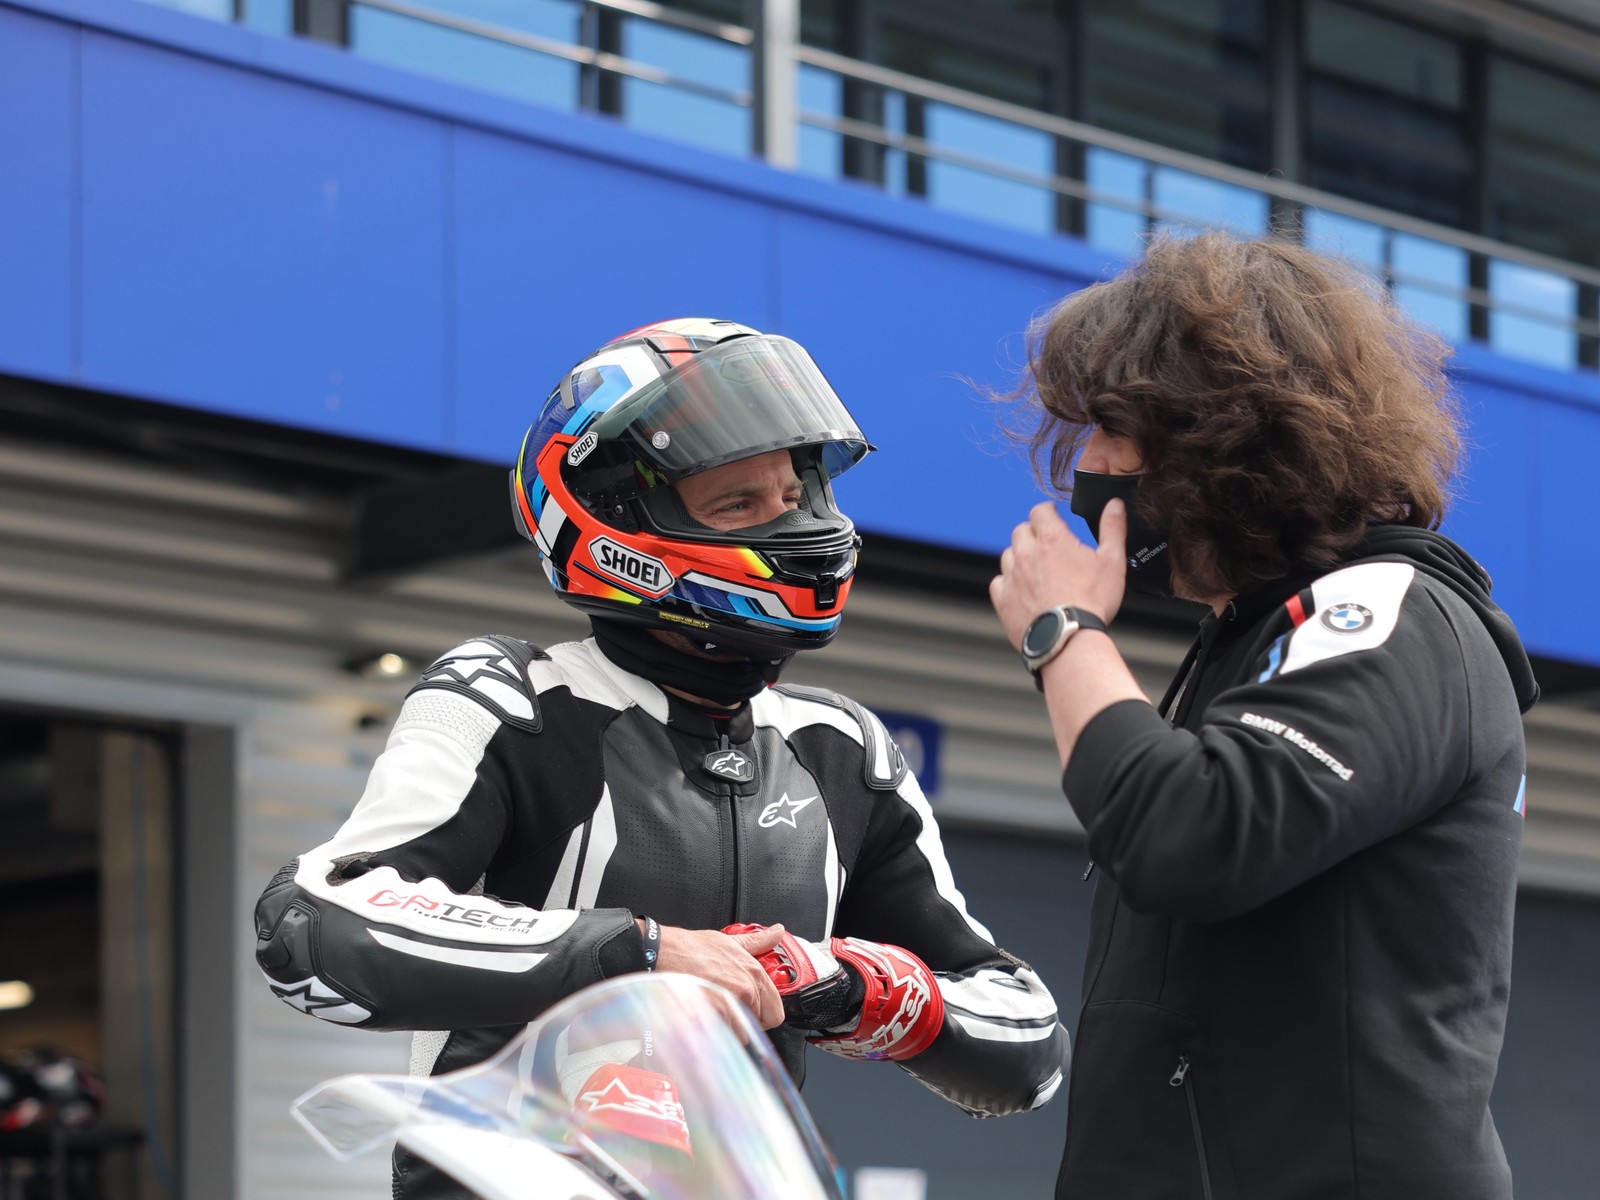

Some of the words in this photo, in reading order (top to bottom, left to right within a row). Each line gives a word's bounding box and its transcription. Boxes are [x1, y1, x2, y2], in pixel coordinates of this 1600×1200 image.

[570, 434, 594, 463] SHOEI
[600, 544, 661, 588] SHOEI
[1140, 542, 1168, 563] MOTORRAD
[1240, 712, 1287, 735] BMW
[1283, 727, 1354, 781] Motorrad
[482, 924, 530, 934] racing
